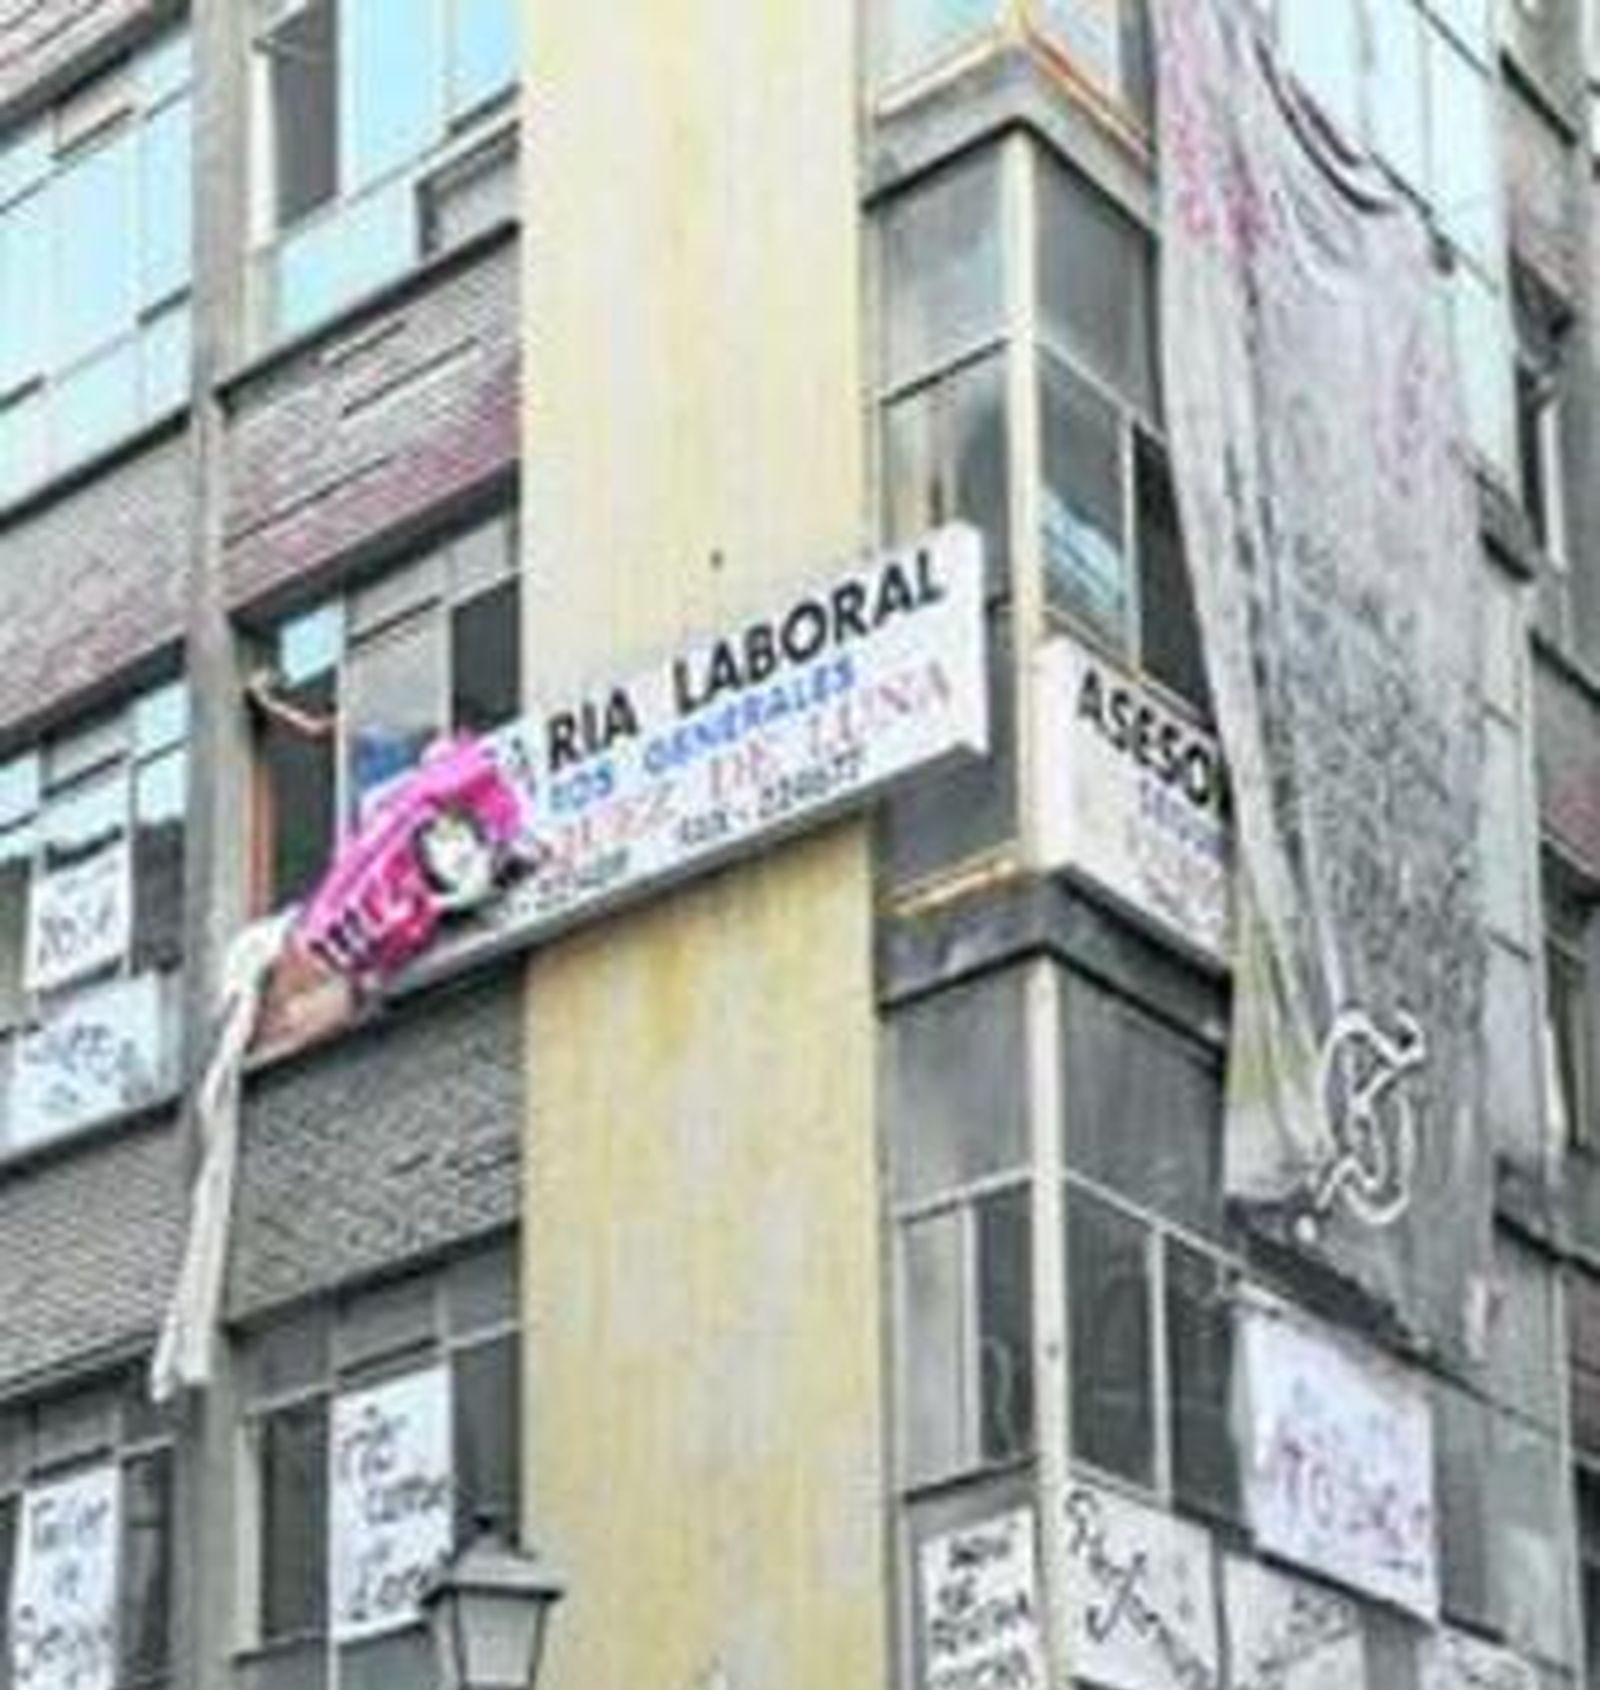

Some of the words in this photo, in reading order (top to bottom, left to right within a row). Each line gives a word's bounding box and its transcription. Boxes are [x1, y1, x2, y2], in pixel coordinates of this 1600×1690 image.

[671, 546, 945, 717] LABORAL
[643, 655, 856, 775] GENERALES
[808, 660, 952, 760] LUNA
[1076, 668, 1213, 806] ASESO
